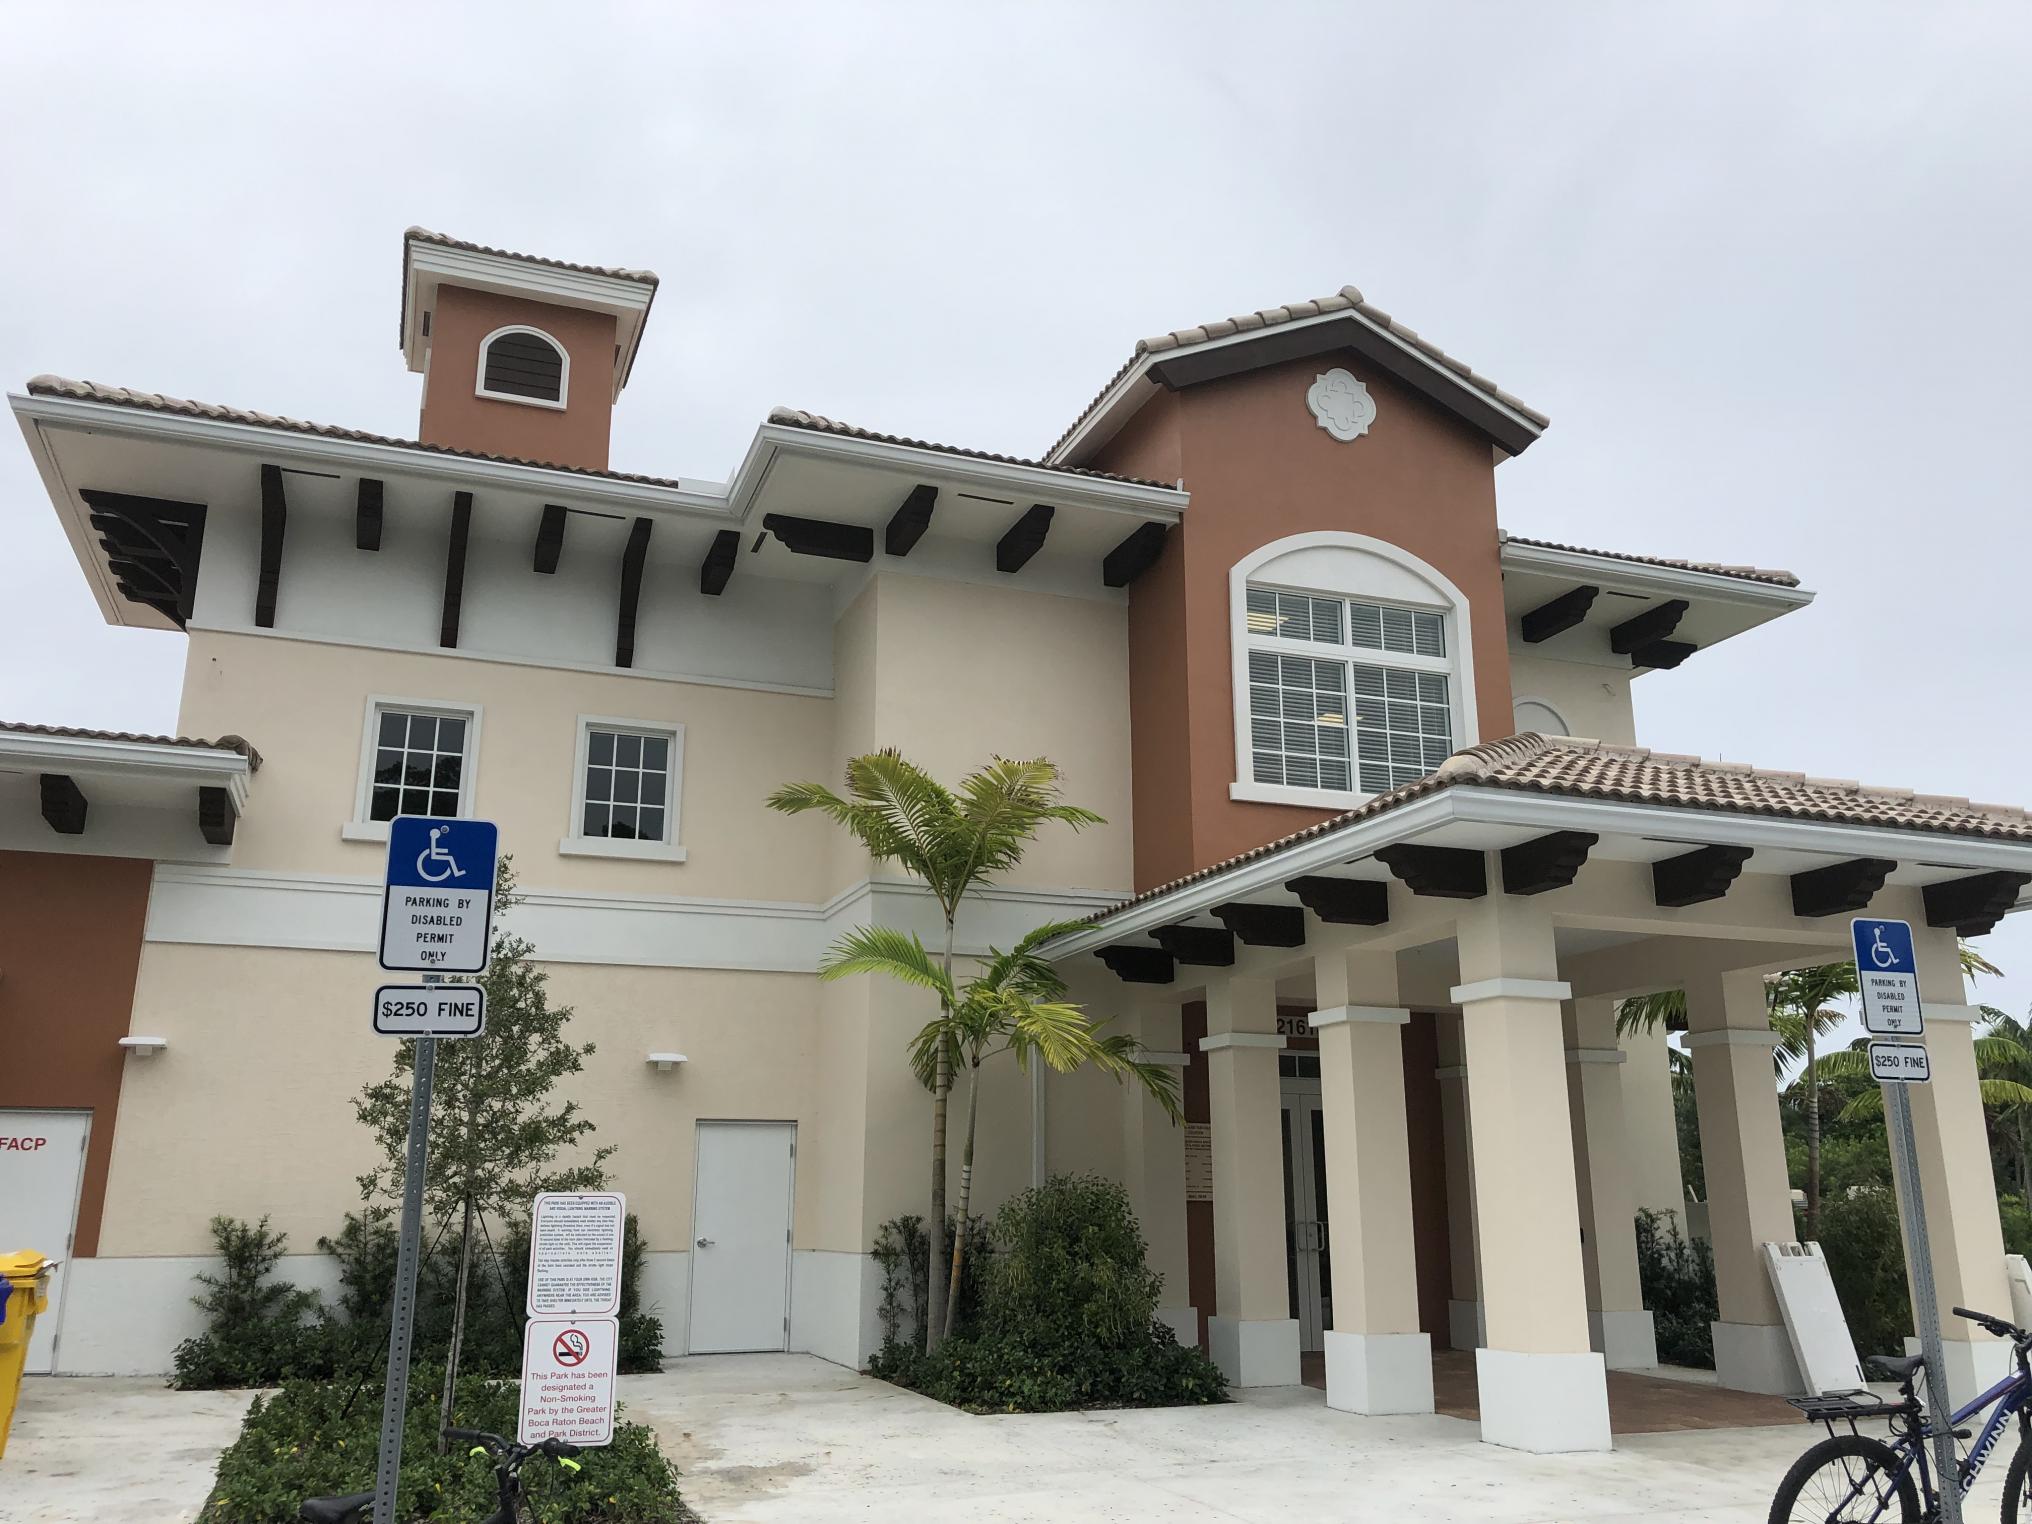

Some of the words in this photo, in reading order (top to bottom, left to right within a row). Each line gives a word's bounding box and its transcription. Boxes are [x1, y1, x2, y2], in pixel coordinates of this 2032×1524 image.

[404, 896, 450, 908] PARKING
[457, 899, 471, 909] BY
[411, 914, 463, 926] DISABLED
[416, 932, 454, 944] PERMIT
[420, 951, 447, 962] ONLY
[1871, 978, 1896, 987] PARKING
[1899, 980, 1907, 988] BY
[1876, 992, 1905, 1001] DISABLED
[381, 1000, 428, 1018] $250
[437, 1002, 476, 1017] FINE
[1882, 1005, 1903, 1014] PERMIT
[1887, 1018, 1902, 1027] ONLY
[1874, 1055, 1899, 1067] $250
[1904, 1057, 1926, 1069] FINE
[0, 1137, 47, 1151] FACP
[531, 1372, 548, 1380] This
[550, 1372, 569, 1380] Park
[588, 1371, 608, 1379] been
[541, 1383, 587, 1393] designated
[540, 1394, 596, 1403] Non-Smoking
[527, 1407, 546, 1415] Park
[549, 1407, 559, 1416] by
[561, 1406, 575, 1414] the
[576, 1405, 607, 1413] Greater
[528, 1419, 550, 1427] Boca
[552, 1418, 577, 1426] Raton
[578, 1417, 605, 1425] Beach
[530, 1431, 546, 1439] and
[548, 1430, 567, 1438] Park
[569, 1429, 601, 1437] District.
